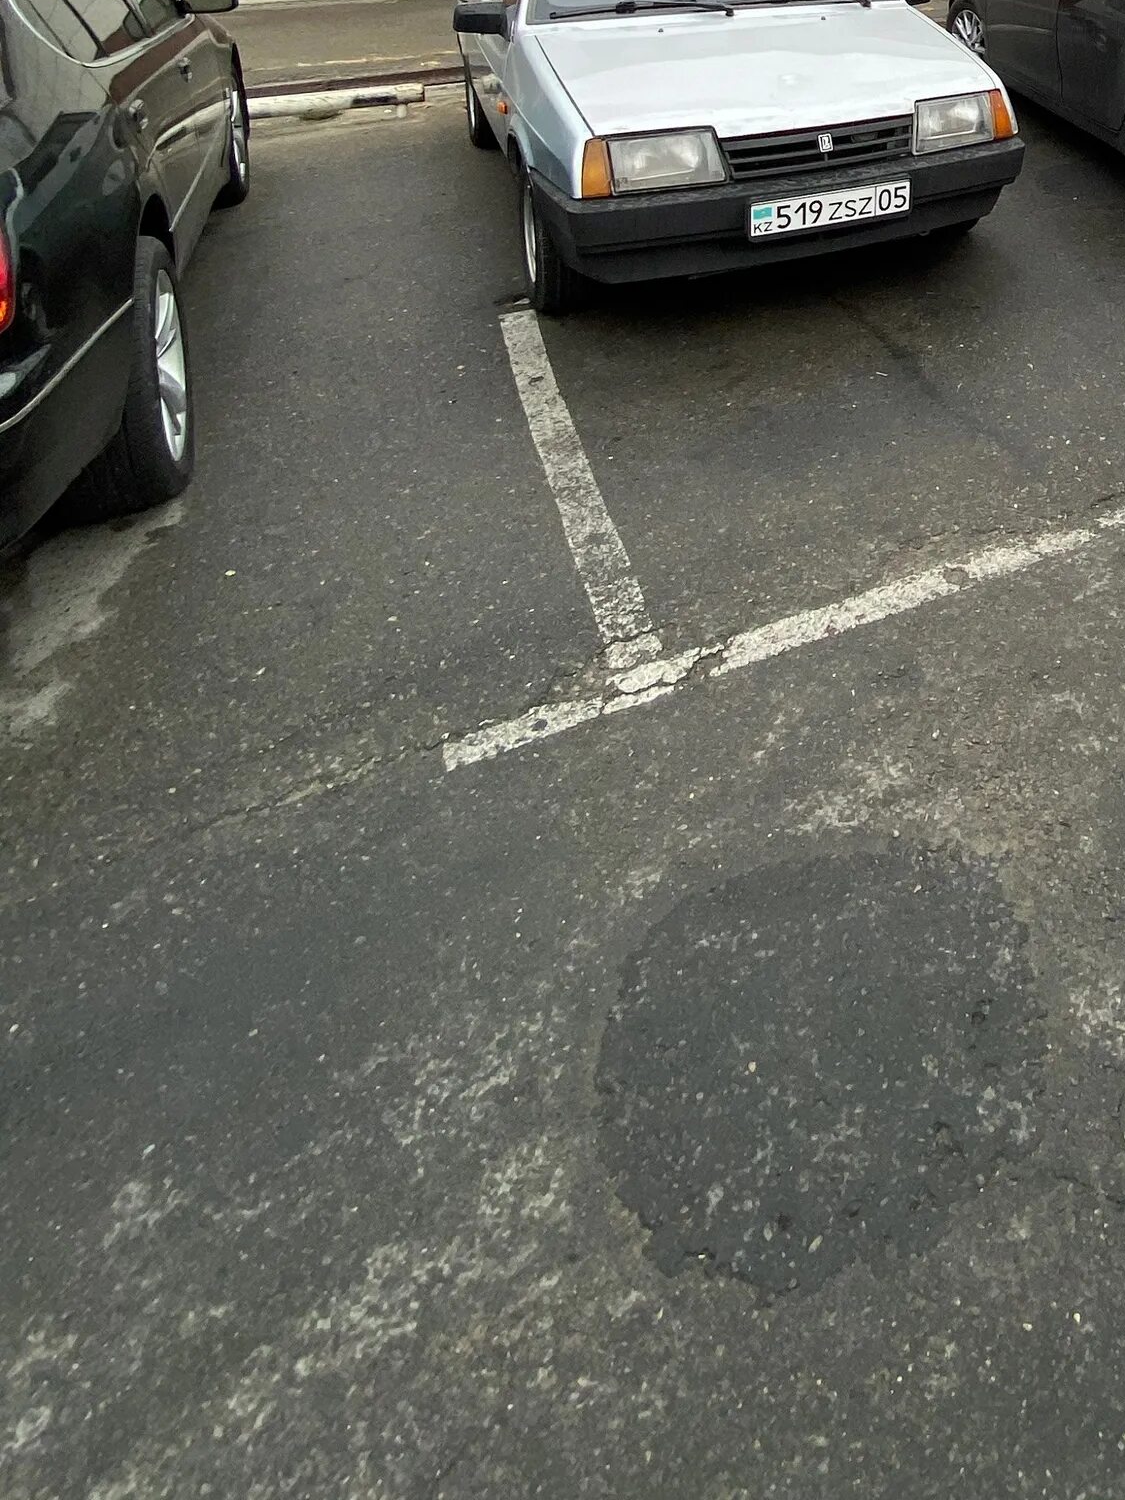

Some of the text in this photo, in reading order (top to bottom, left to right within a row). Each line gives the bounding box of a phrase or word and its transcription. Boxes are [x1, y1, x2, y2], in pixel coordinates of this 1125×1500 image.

[776, 186, 907, 229] 519 ZSZ 05
[753, 221, 773, 234] KZ
